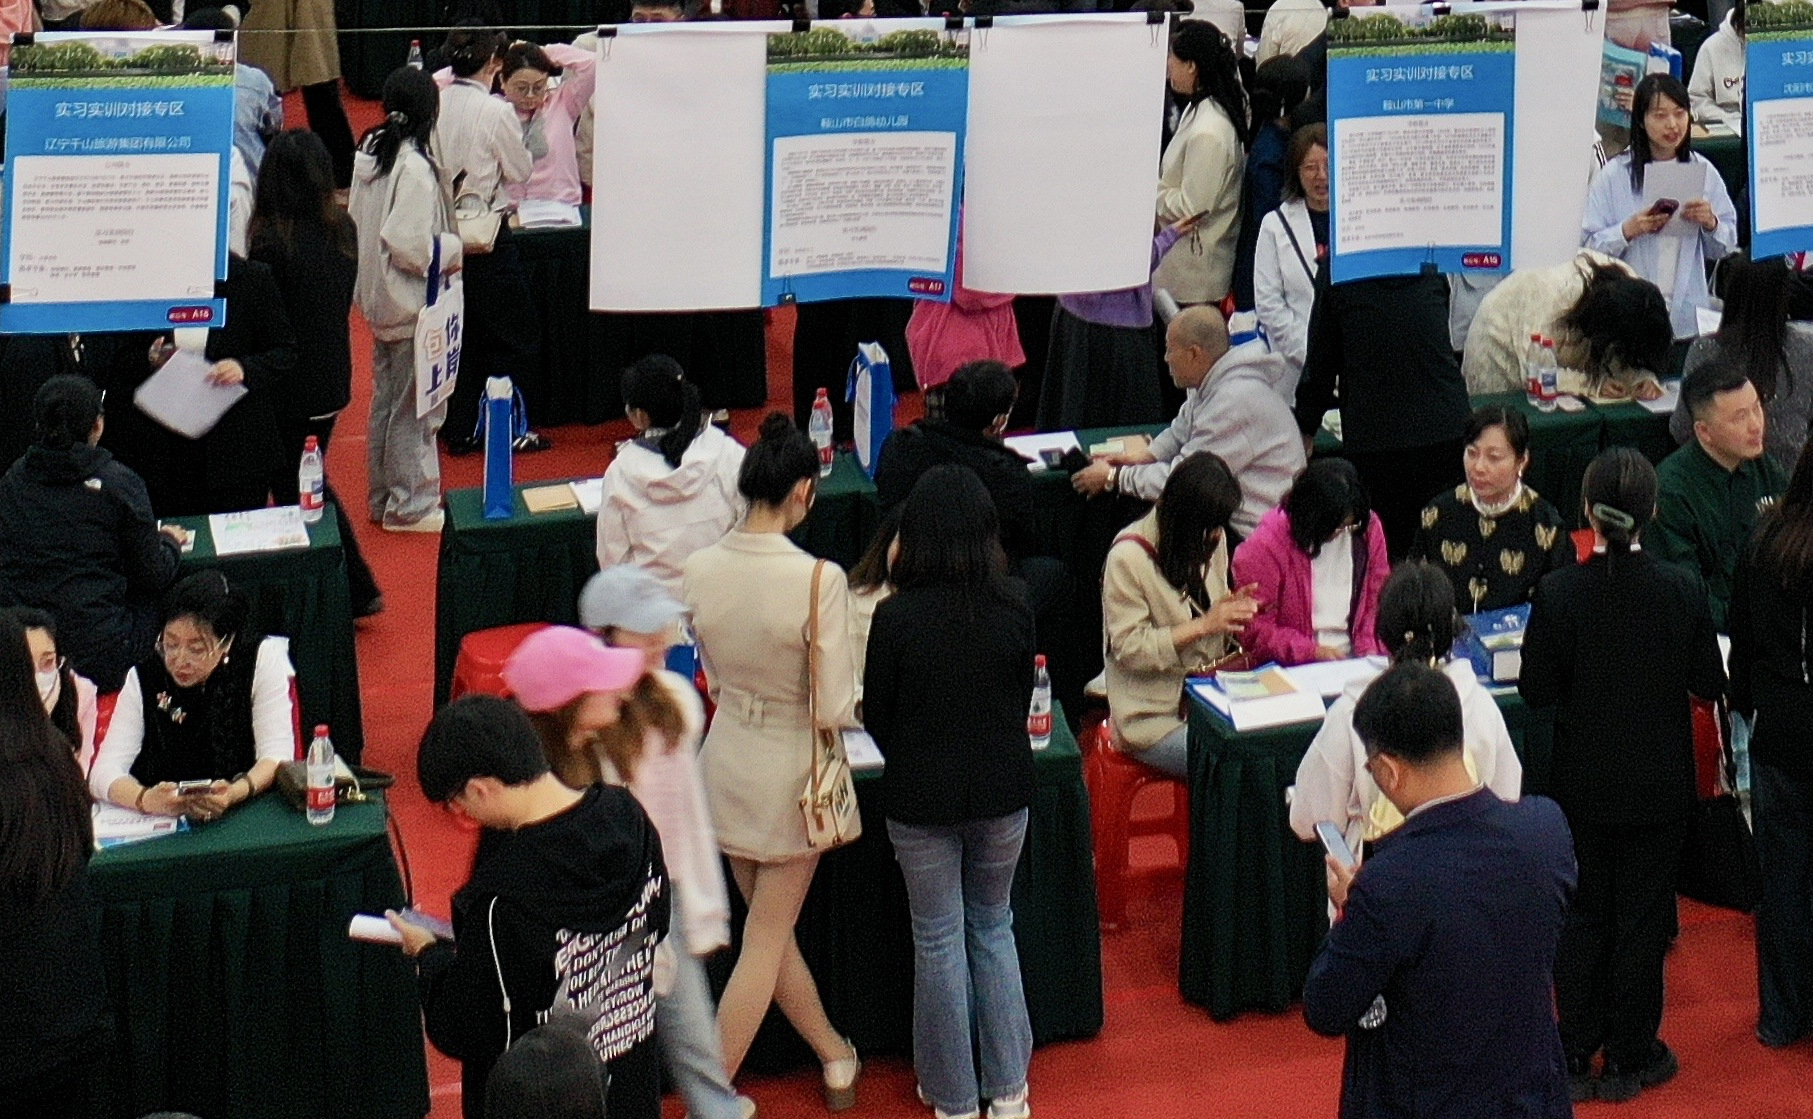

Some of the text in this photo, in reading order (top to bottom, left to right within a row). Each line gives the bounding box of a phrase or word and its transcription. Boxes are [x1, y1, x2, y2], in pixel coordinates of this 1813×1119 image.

[1366, 65, 1475, 83] 实习实训对接专区
[808, 82, 925, 99] 实习实训对接专区
[54, 100, 186, 118] 实习实训对接专区
[1382, 98, 1456, 111] 鞍山市第一中学
[44, 136, 193, 151] 辽宁千山旅游集团有限公司
